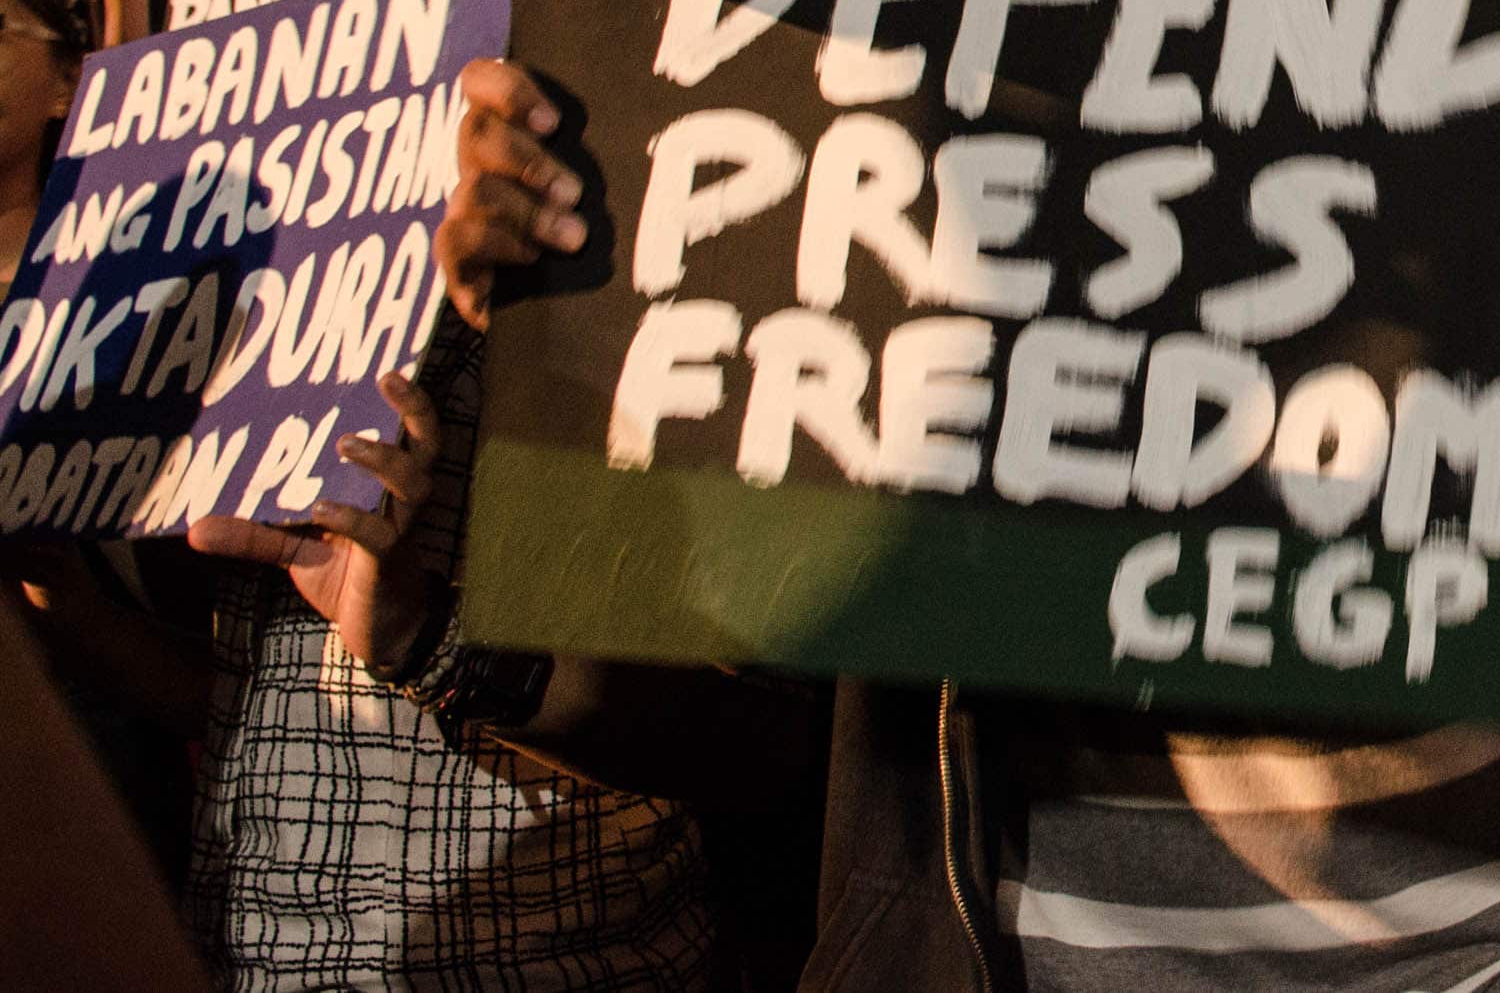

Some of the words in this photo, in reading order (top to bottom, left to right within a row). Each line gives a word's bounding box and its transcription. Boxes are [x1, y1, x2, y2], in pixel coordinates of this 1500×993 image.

[31, 181, 156, 263] ANG
[633, 109, 1379, 343] PRESS
[1110, 527, 1490, 684] CEGP
